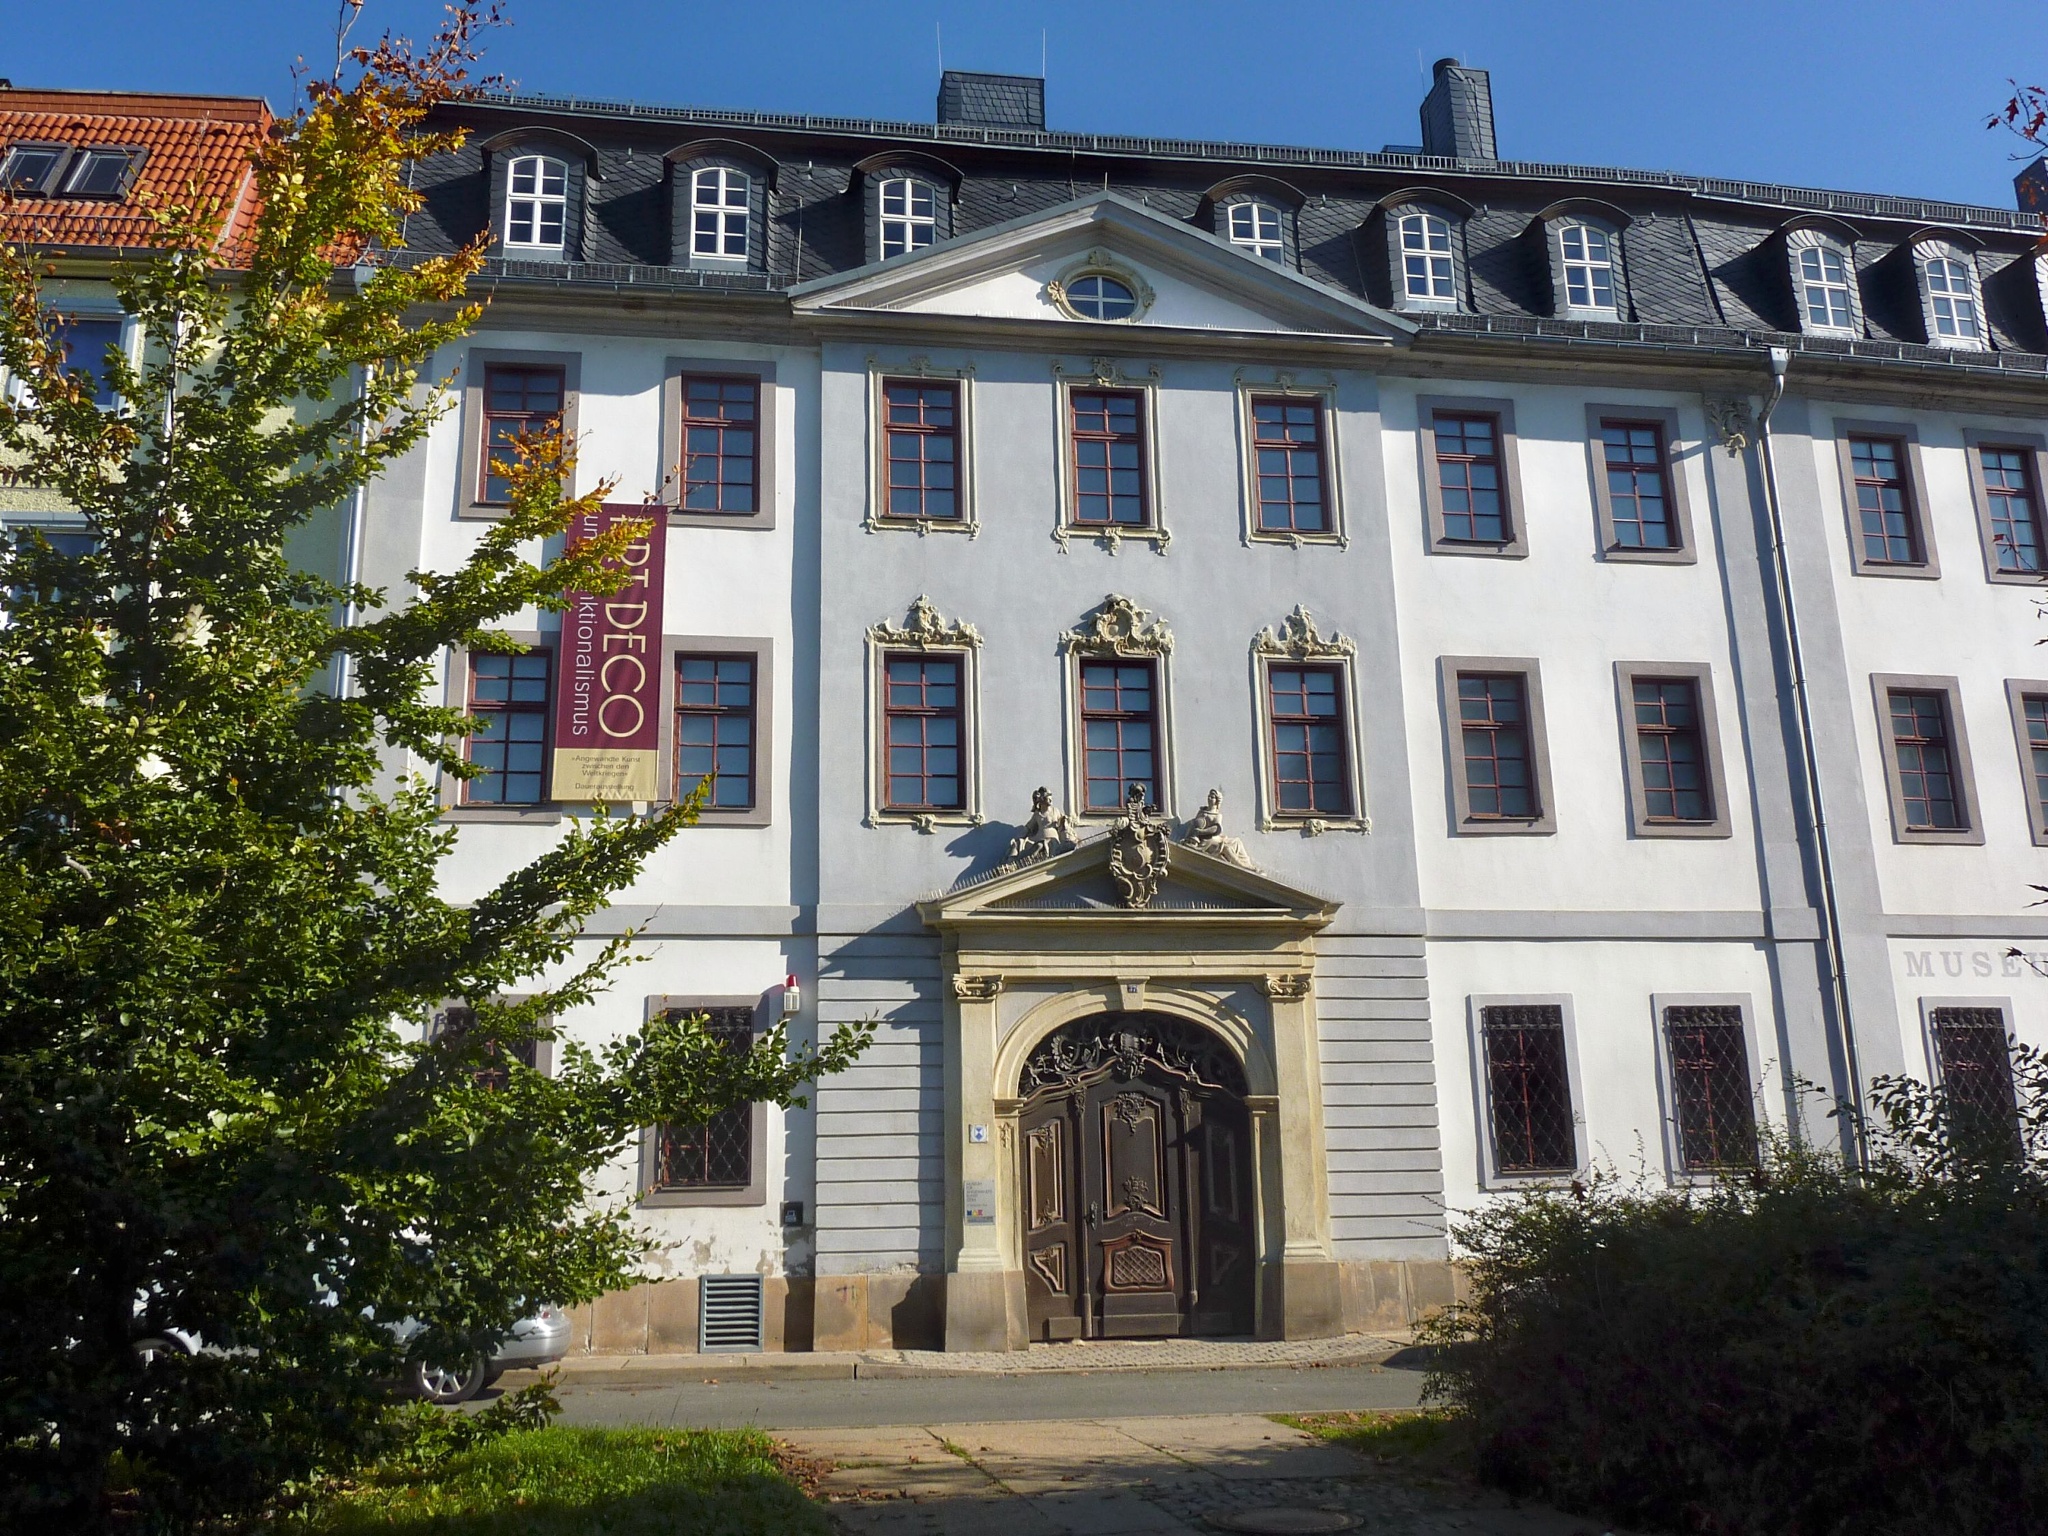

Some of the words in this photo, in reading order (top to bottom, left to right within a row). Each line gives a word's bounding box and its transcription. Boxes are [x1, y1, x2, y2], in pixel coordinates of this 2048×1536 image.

[582, 514, 600, 547] un
[598, 601, 648, 739] DECO
[575, 783, 635, 791] Dauerausstellung
